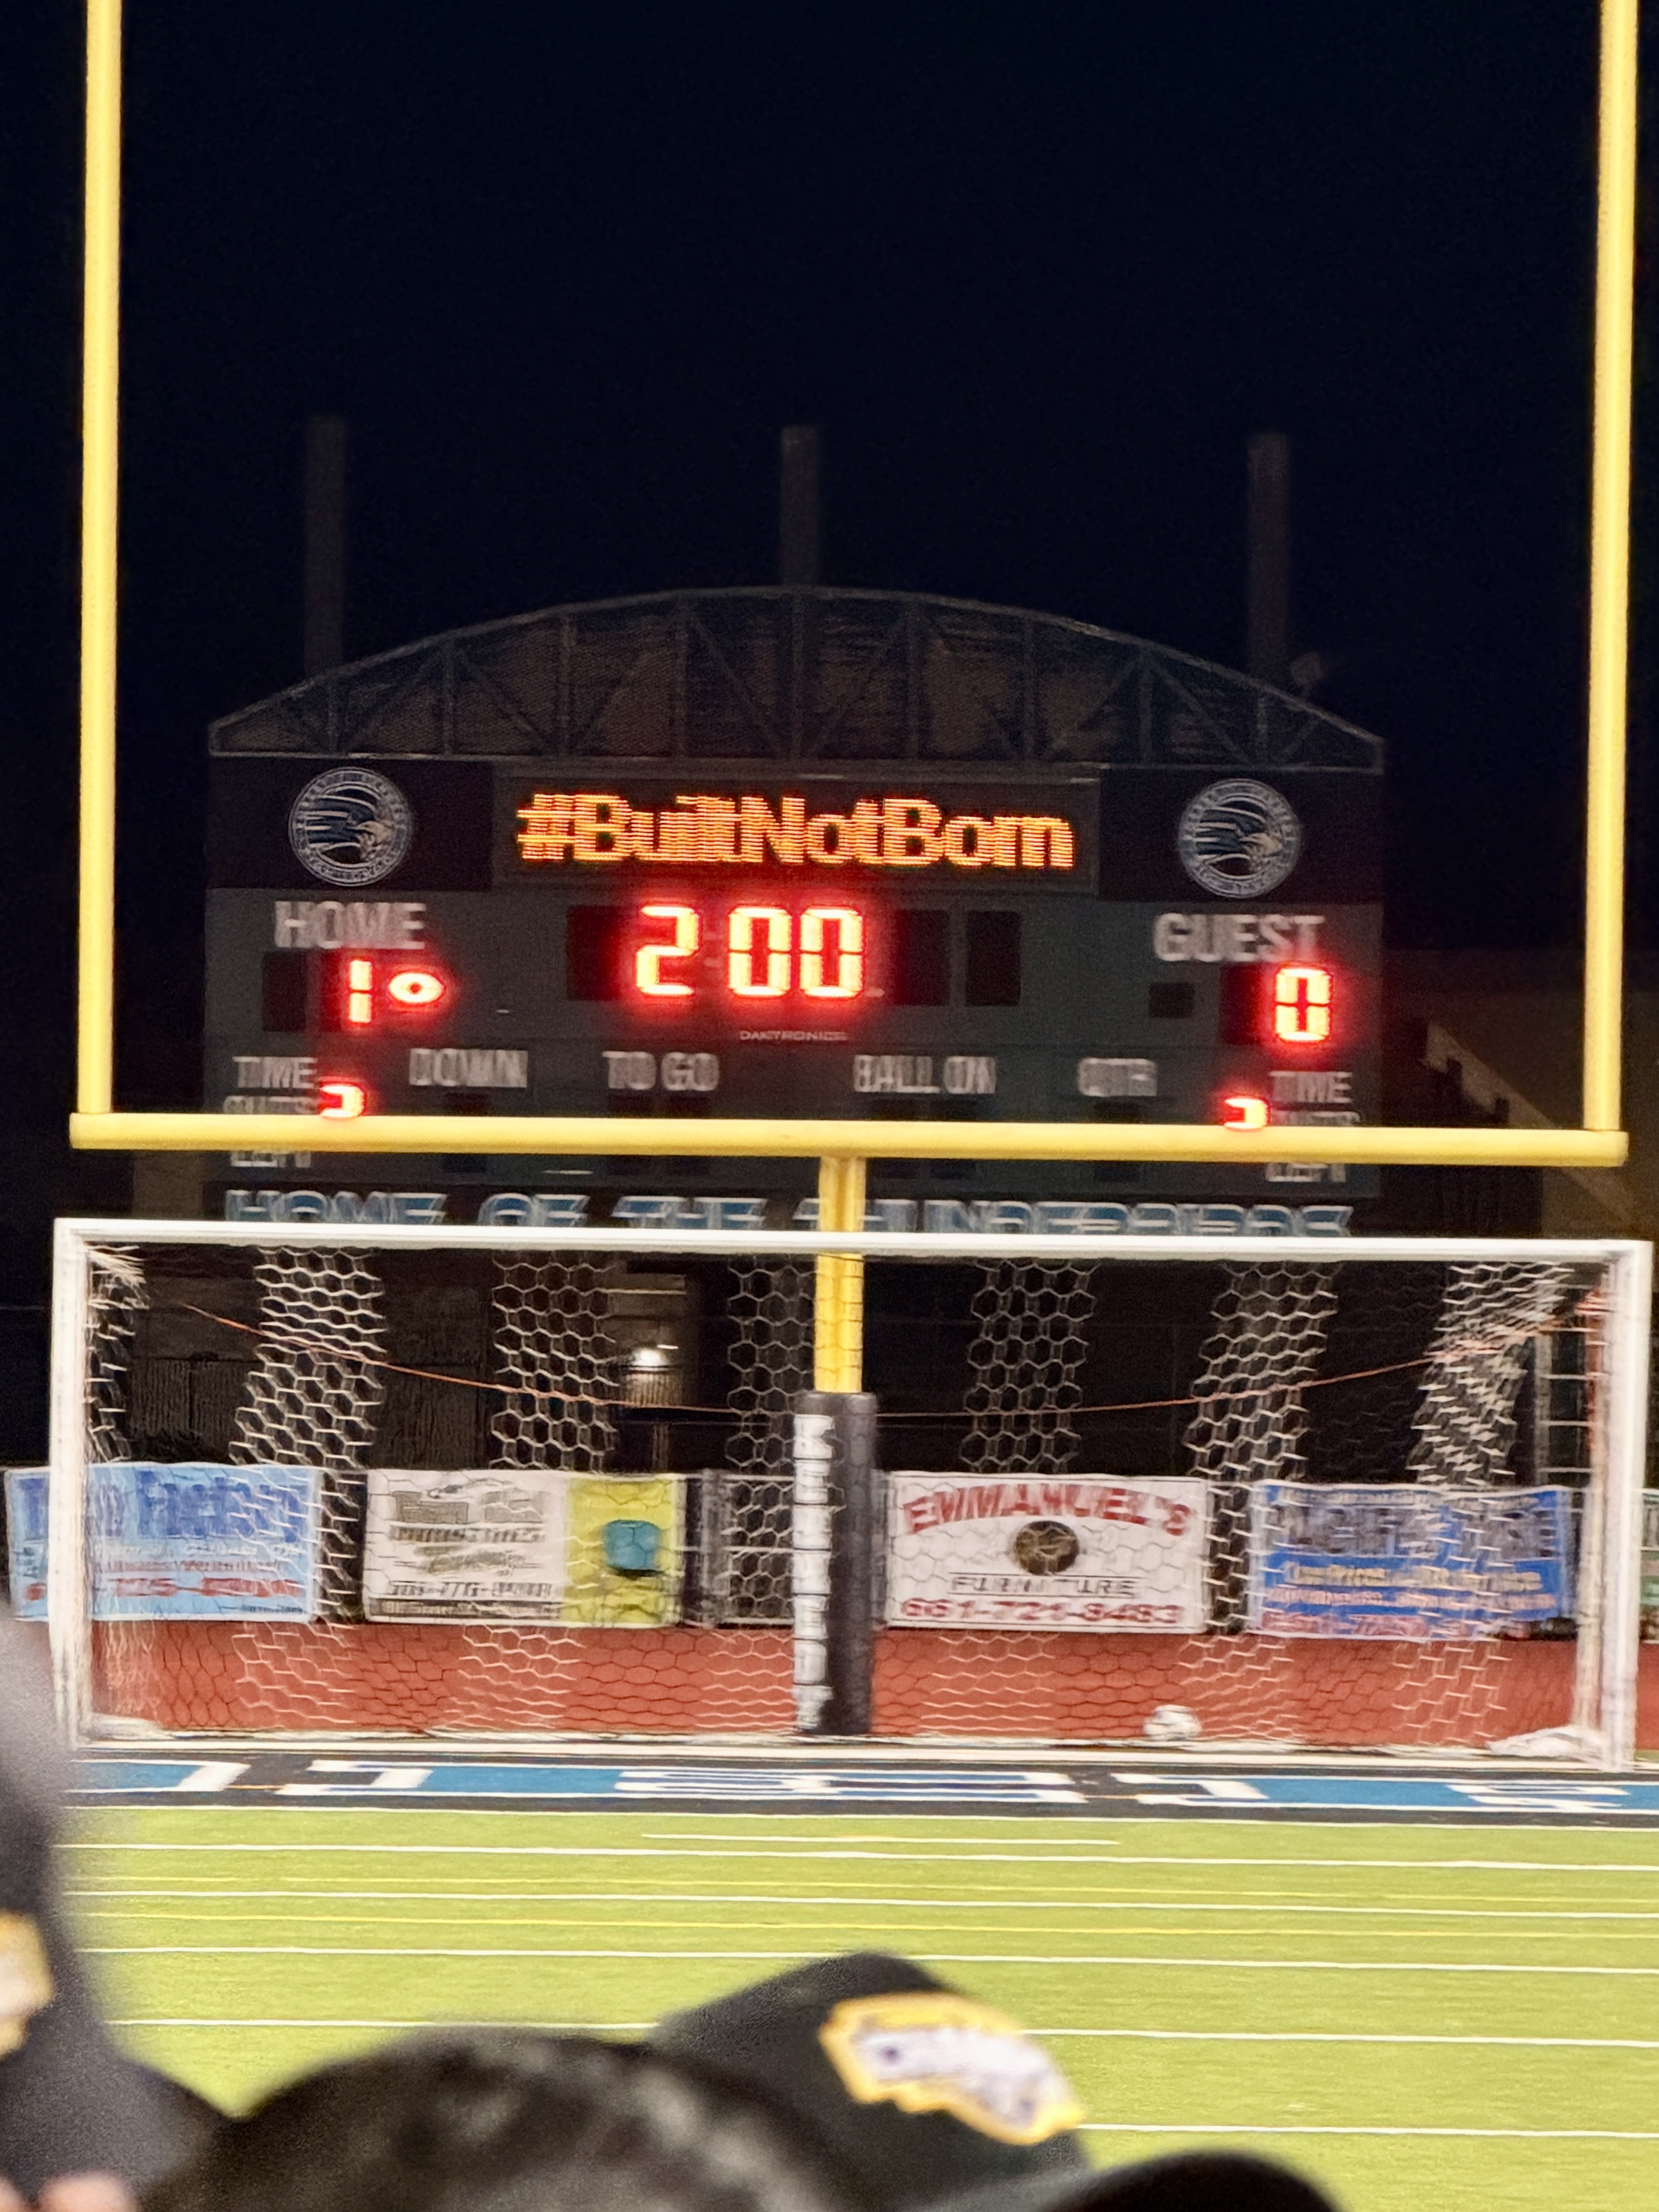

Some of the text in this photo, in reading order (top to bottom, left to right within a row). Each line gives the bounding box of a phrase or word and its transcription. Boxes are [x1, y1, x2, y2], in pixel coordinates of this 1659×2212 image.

[274, 901, 426, 950] HOME
[1154, 912, 1326, 962] GUEST
[1274, 967, 1332, 1042] 0
[231, 1056, 318, 1088] TIME
[409, 1048, 528, 1088] DOWN
[661, 1052, 720, 1091] GO
[853, 1055, 997, 1095] BALL ON
[1269, 1071, 1354, 1103] TIME
[225, 1189, 447, 1222] HOME
